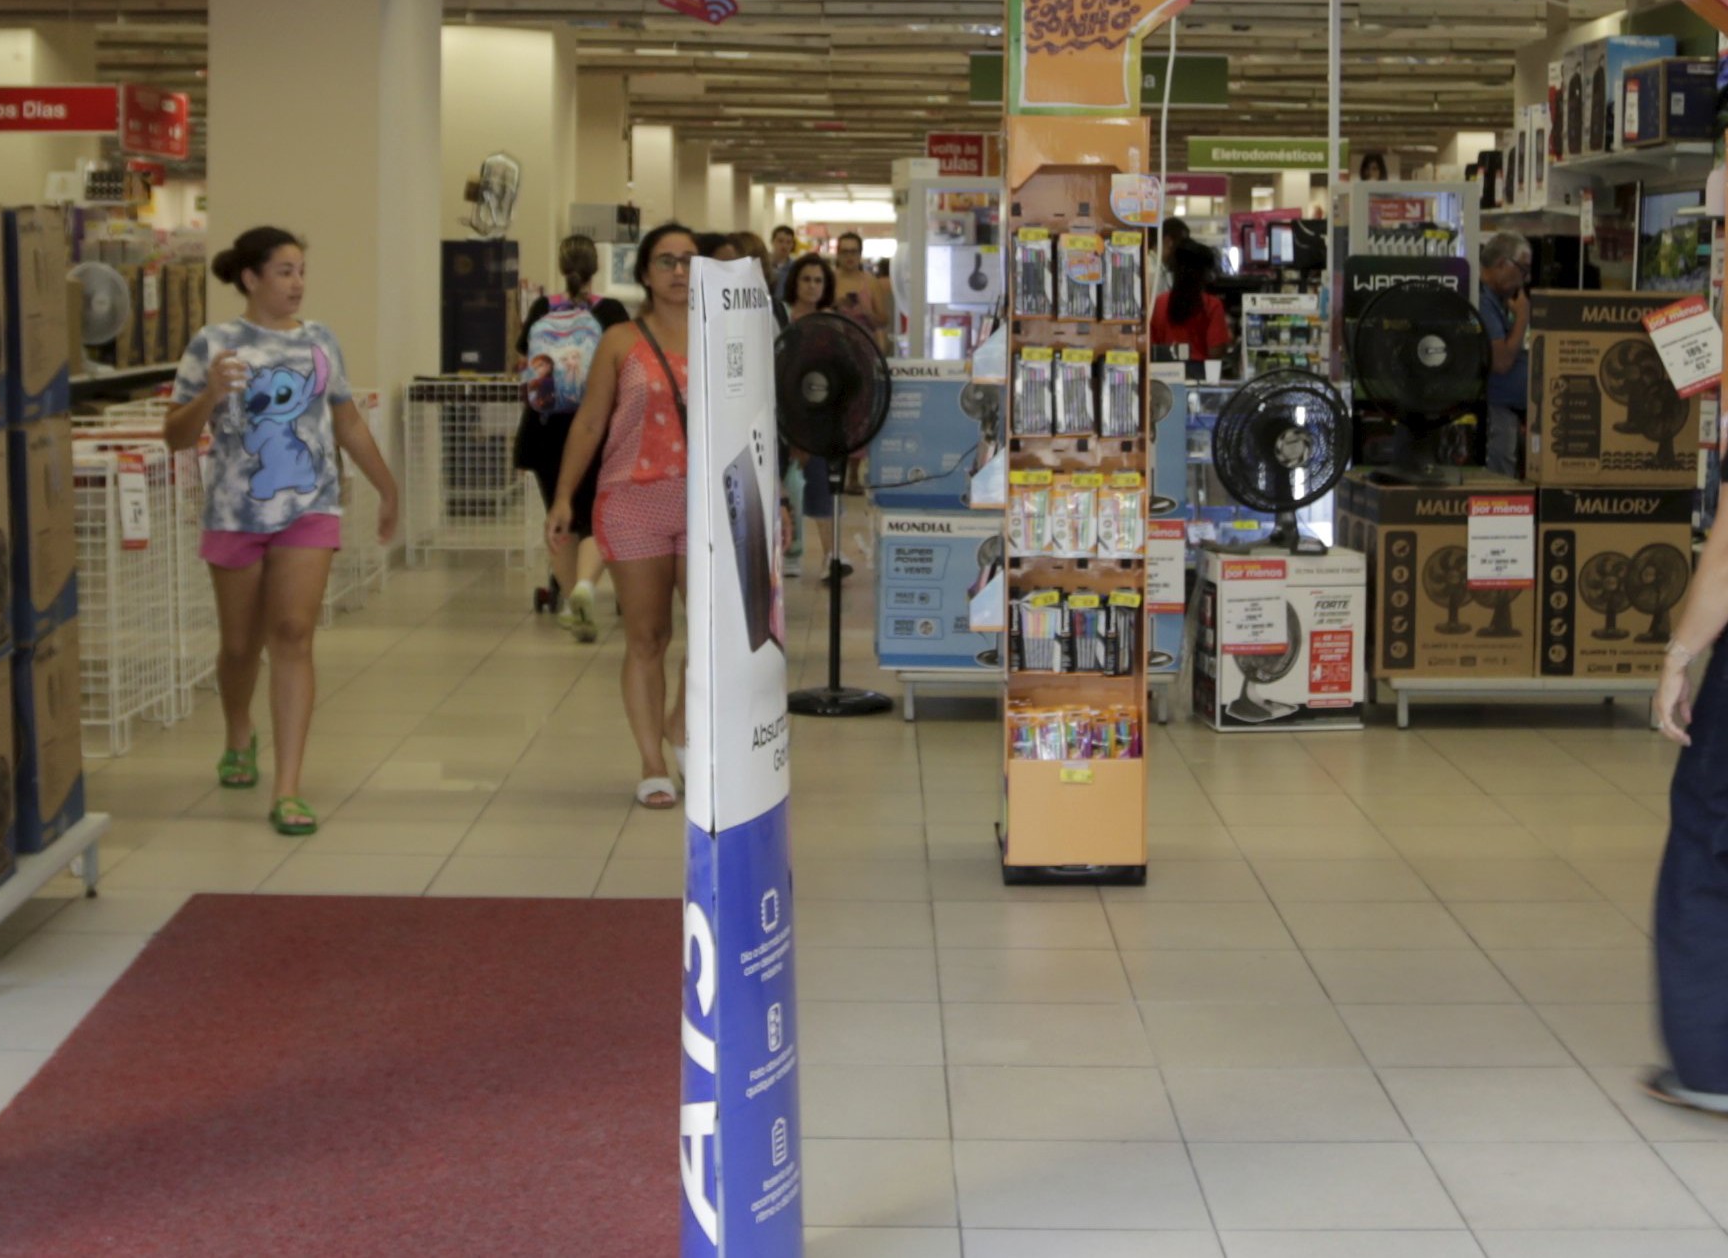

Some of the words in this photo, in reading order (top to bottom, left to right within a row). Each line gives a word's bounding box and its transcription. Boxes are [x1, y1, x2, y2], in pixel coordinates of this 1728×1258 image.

[22, 100, 67, 119] Dias
[1212, 146, 1324, 163] Eletrodomésticos
[1668, 303, 1705, 324] menos
[1472, 505, 1490, 516] por
[1492, 504, 1531, 514] menos
[1575, 497, 1660, 515] MALLORY
[887, 522, 953, 534] MONDIAL
[1225, 569, 1245, 579] por
[1247, 568, 1283, 579] menos
[1314, 600, 1351, 611] FORTE
